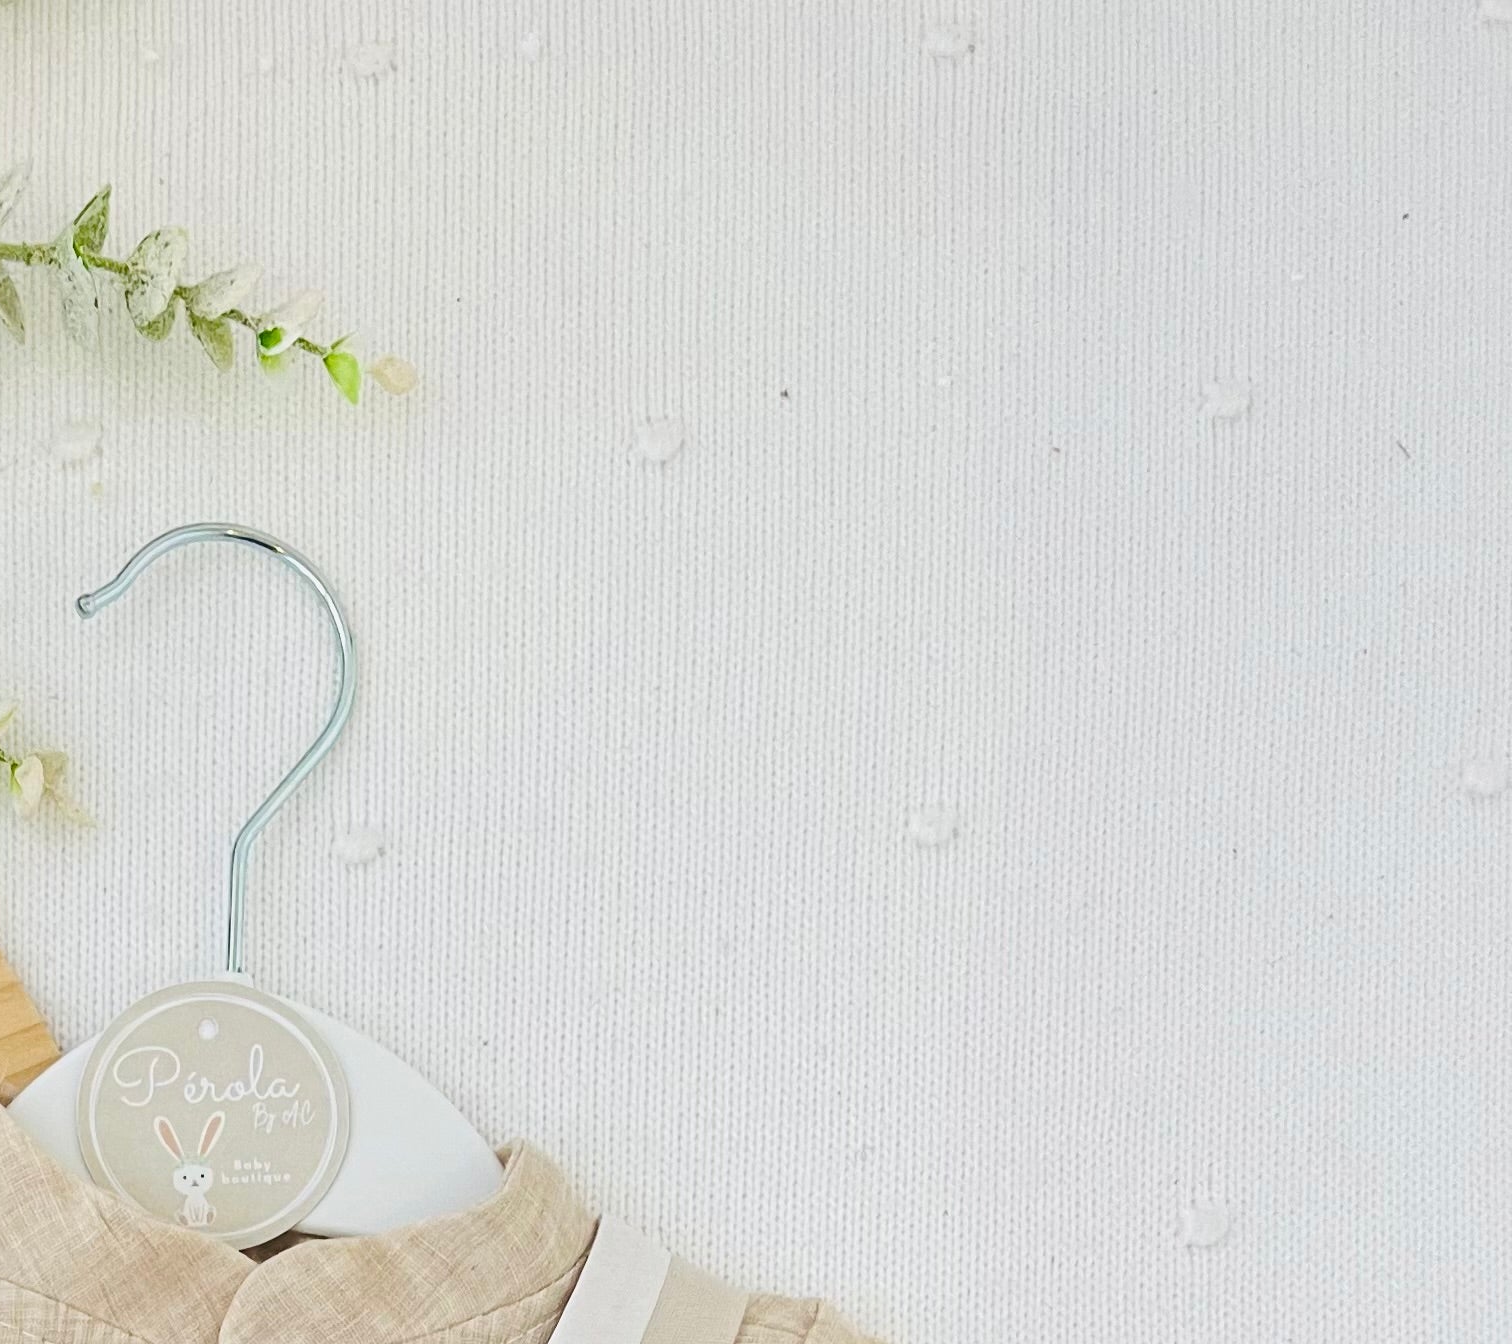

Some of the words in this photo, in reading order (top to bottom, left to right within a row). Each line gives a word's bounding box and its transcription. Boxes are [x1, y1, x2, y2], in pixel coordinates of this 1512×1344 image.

[113, 1043, 301, 1107] Pérola
[252, 1101, 277, 1133] By
[233, 1158, 272, 1171] Baby
[221, 1171, 292, 1186] boutique
